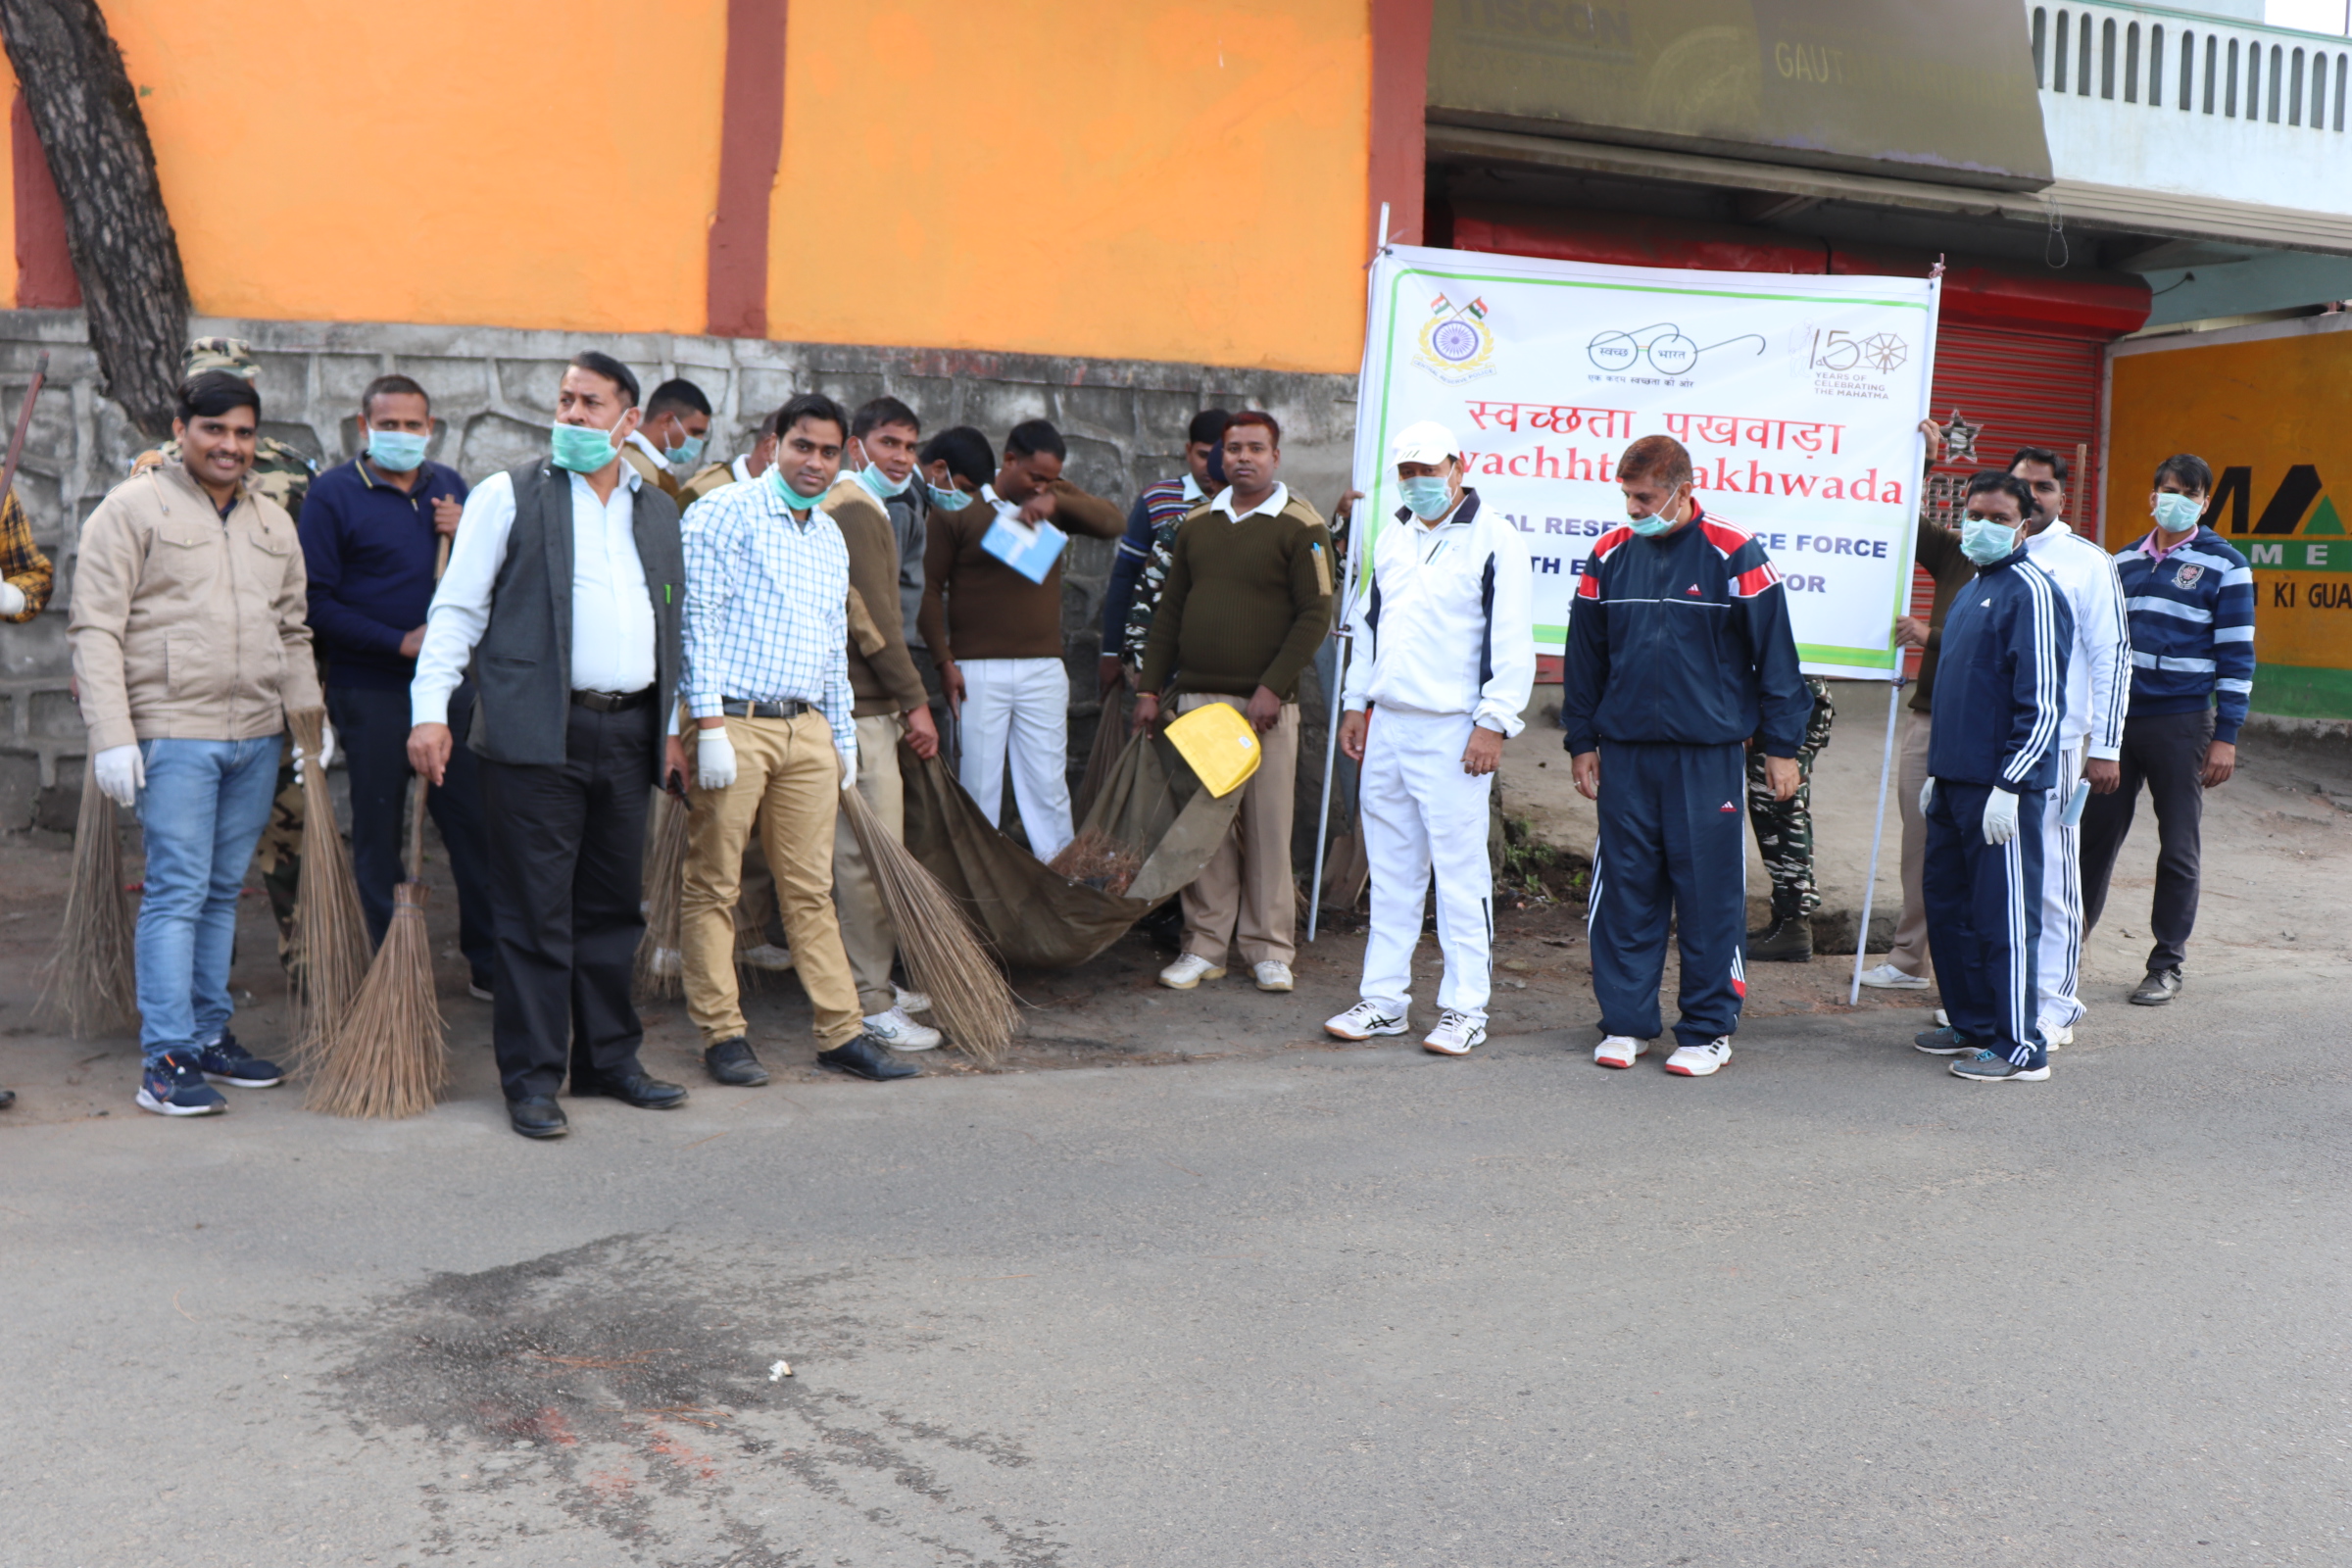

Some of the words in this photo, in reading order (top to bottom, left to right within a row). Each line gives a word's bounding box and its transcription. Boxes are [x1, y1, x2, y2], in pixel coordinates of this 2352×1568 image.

[1658, 349, 1686, 360] भारत
[1468, 368, 1494, 380] POLICE
[1816, 371, 1850, 381] YEARS
[1852, 373, 1868, 382] OF
[1814, 379, 1886, 392] CELEBRATING
[1814, 387, 1835, 396] THE
[1837, 389, 1889, 400] MAHATMA
[1465, 400, 1638, 439] स्वच्छता
[1662, 413, 1846, 459] पखवाड़ा
[1796, 534, 1888, 559] FORCE
[2275, 582, 2296, 608] KI
